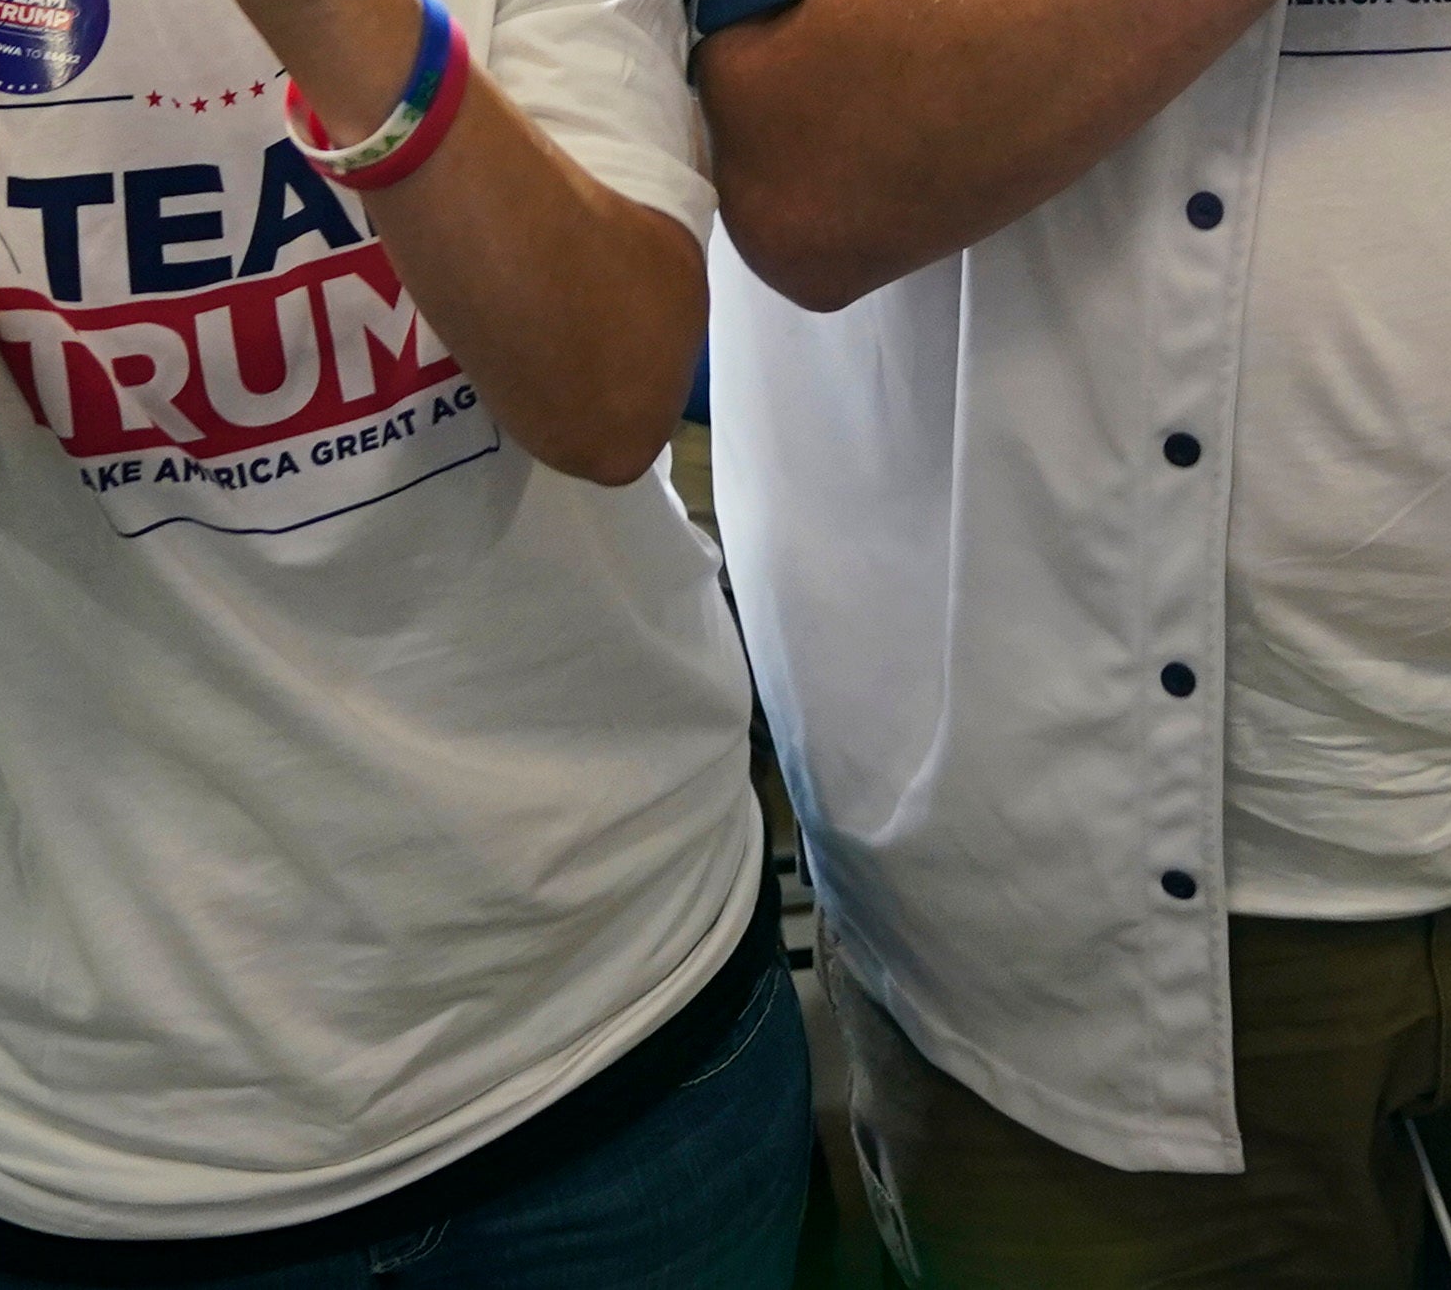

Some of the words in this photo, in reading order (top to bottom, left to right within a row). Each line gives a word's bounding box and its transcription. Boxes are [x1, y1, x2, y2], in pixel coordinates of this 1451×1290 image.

[26, 48, 43, 59] TO
[7, 137, 378, 302] TEA
[154, 450, 300, 491] AMRICA
[311, 408, 417, 467] GREAT
[432, 383, 479, 427] AG
